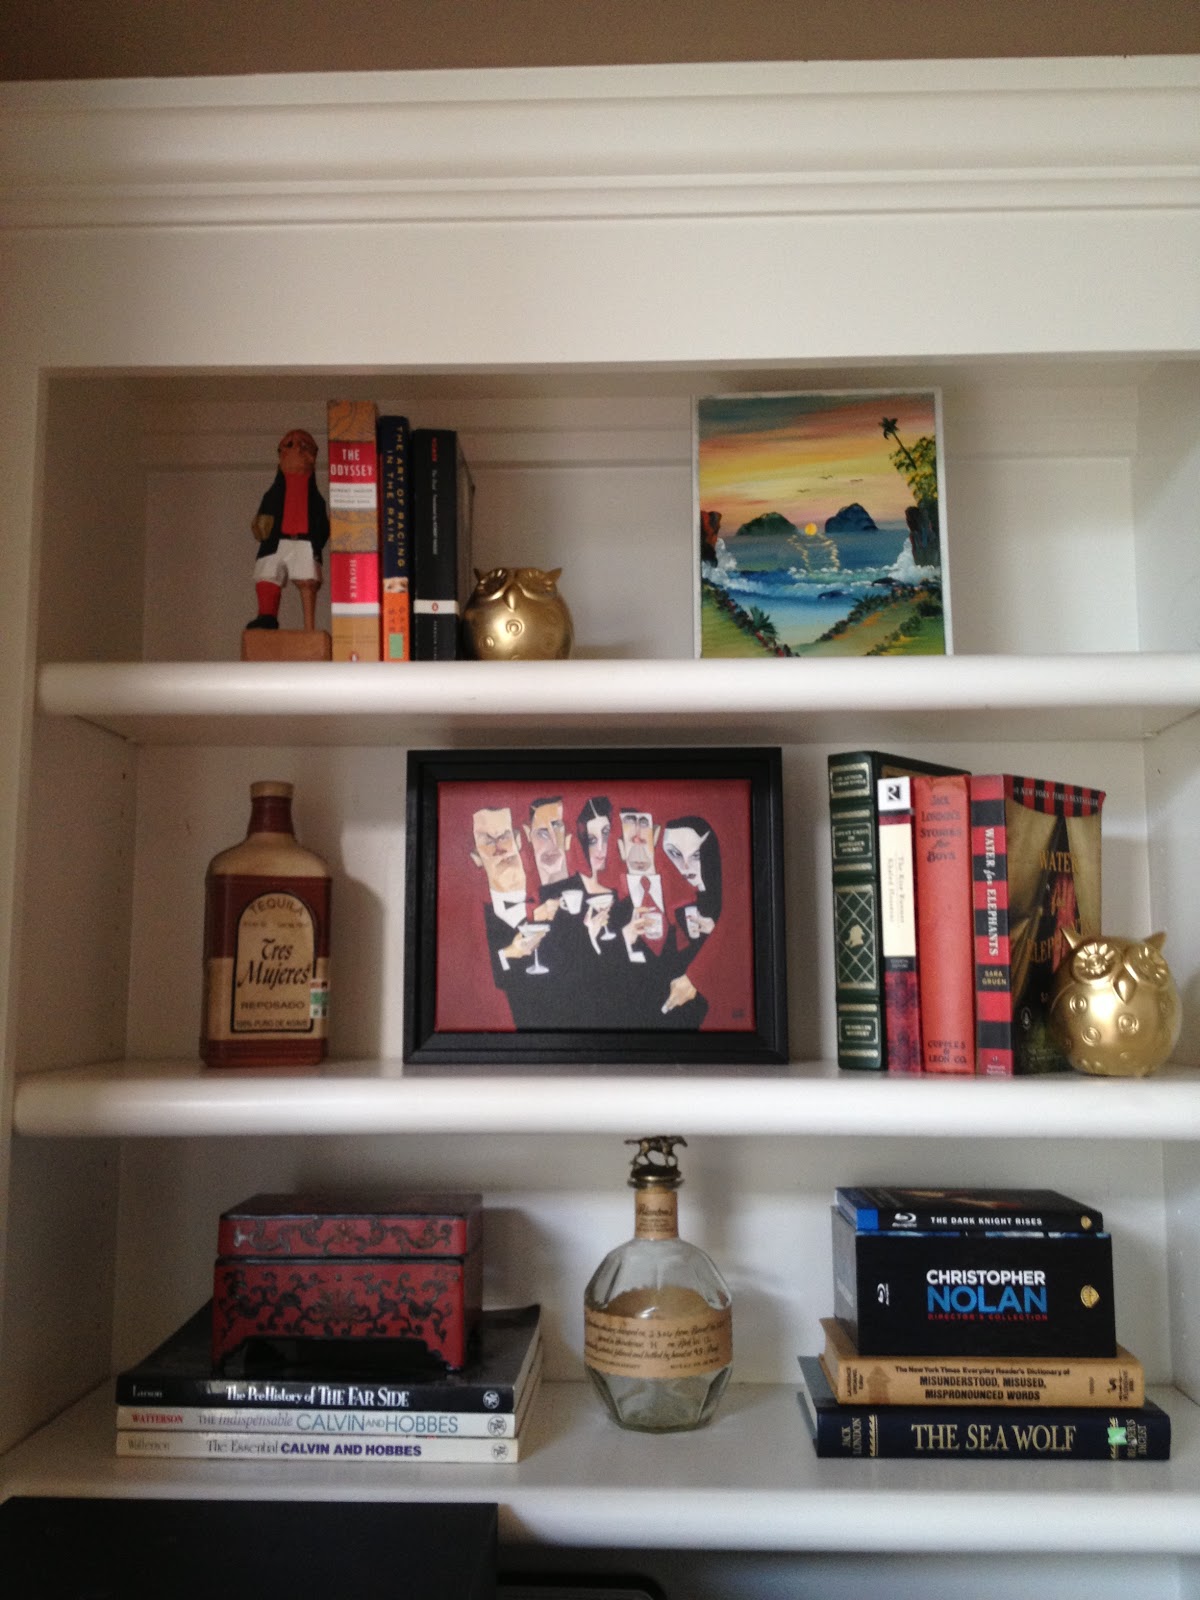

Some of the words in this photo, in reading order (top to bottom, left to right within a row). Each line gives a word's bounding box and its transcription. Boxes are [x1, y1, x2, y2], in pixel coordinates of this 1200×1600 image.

[396, 425, 405, 452] THE
[342, 449, 360, 461] THE
[330, 464, 373, 477] ODYSSEY
[396, 457, 405, 483] ART
[386, 472, 395, 499] THE
[396, 488, 405, 506] OF
[387, 507, 395, 542] RAIN
[397, 512, 406, 568] RACING
[985, 828, 995, 868] WATER
[1040, 850, 1080, 874] WATER
[983, 868, 996, 885] for
[249, 897, 303, 916] TEQUILA
[987, 888, 999, 956] ELEPHANTS
[262, 938, 294, 960] Tres
[237, 960, 311, 990] Mujeres
[982, 978, 1007, 986] GRUEN
[240, 1001, 305, 1010] REPOSADO
[931, 1216, 947, 1224] THE
[951, 1216, 975, 1225] DARK
[978, 1217, 1012, 1225] KNIGHT
[1015, 1217, 1042, 1226] RISES
[926, 1269, 1046, 1286] CHRISTOPHER
[927, 1286, 1048, 1313] NOLAN
[928, 1313, 984, 1321] DIRECTOR'S
[988, 1313, 1048, 1321] COLLECTION
[941, 1366, 961, 1374] Times
[962, 1366, 994, 1376] Everyday
[996, 1367, 1025, 1375] Reader's
[1026, 1368, 1062, 1376] Dictionary
[919, 1376, 1000, 1388] MISUNDERSTOOD,
[1003, 1377, 1047, 1389] MISUSED,
[226, 1384, 246, 1401] The
[248, 1385, 302, 1403] PreHistory
[304, 1385, 316, 1404] of
[317, 1385, 345, 1406] THE
[348, 1387, 375, 1407] FAR
[377, 1387, 410, 1408] SIDE
[925, 1389, 1004, 1400] MISPRONOUNCED
[1006, 1390, 1040, 1400] WORDS
[132, 1413, 183, 1424] WATTERSON
[199, 1415, 215, 1425] THE
[296, 1413, 365, 1432] CALVIN
[366, 1419, 385, 1428] AND
[386, 1415, 459, 1434] HOBBES
[841, 1426, 851, 1447] JACK
[852, 1417, 862, 1455] LONDON
[911, 1424, 960, 1450] THE
[966, 1423, 1010, 1450] SEA
[1011, 1424, 1077, 1451] WOLF
[1137, 1425, 1147, 1455] DIGEST
[207, 1440, 227, 1452] The
[231, 1440, 278, 1454] Essential
[280, 1443, 330, 1455] CALVIN
[333, 1444, 362, 1456] AND
[365, 1445, 422, 1457] HOBBES
